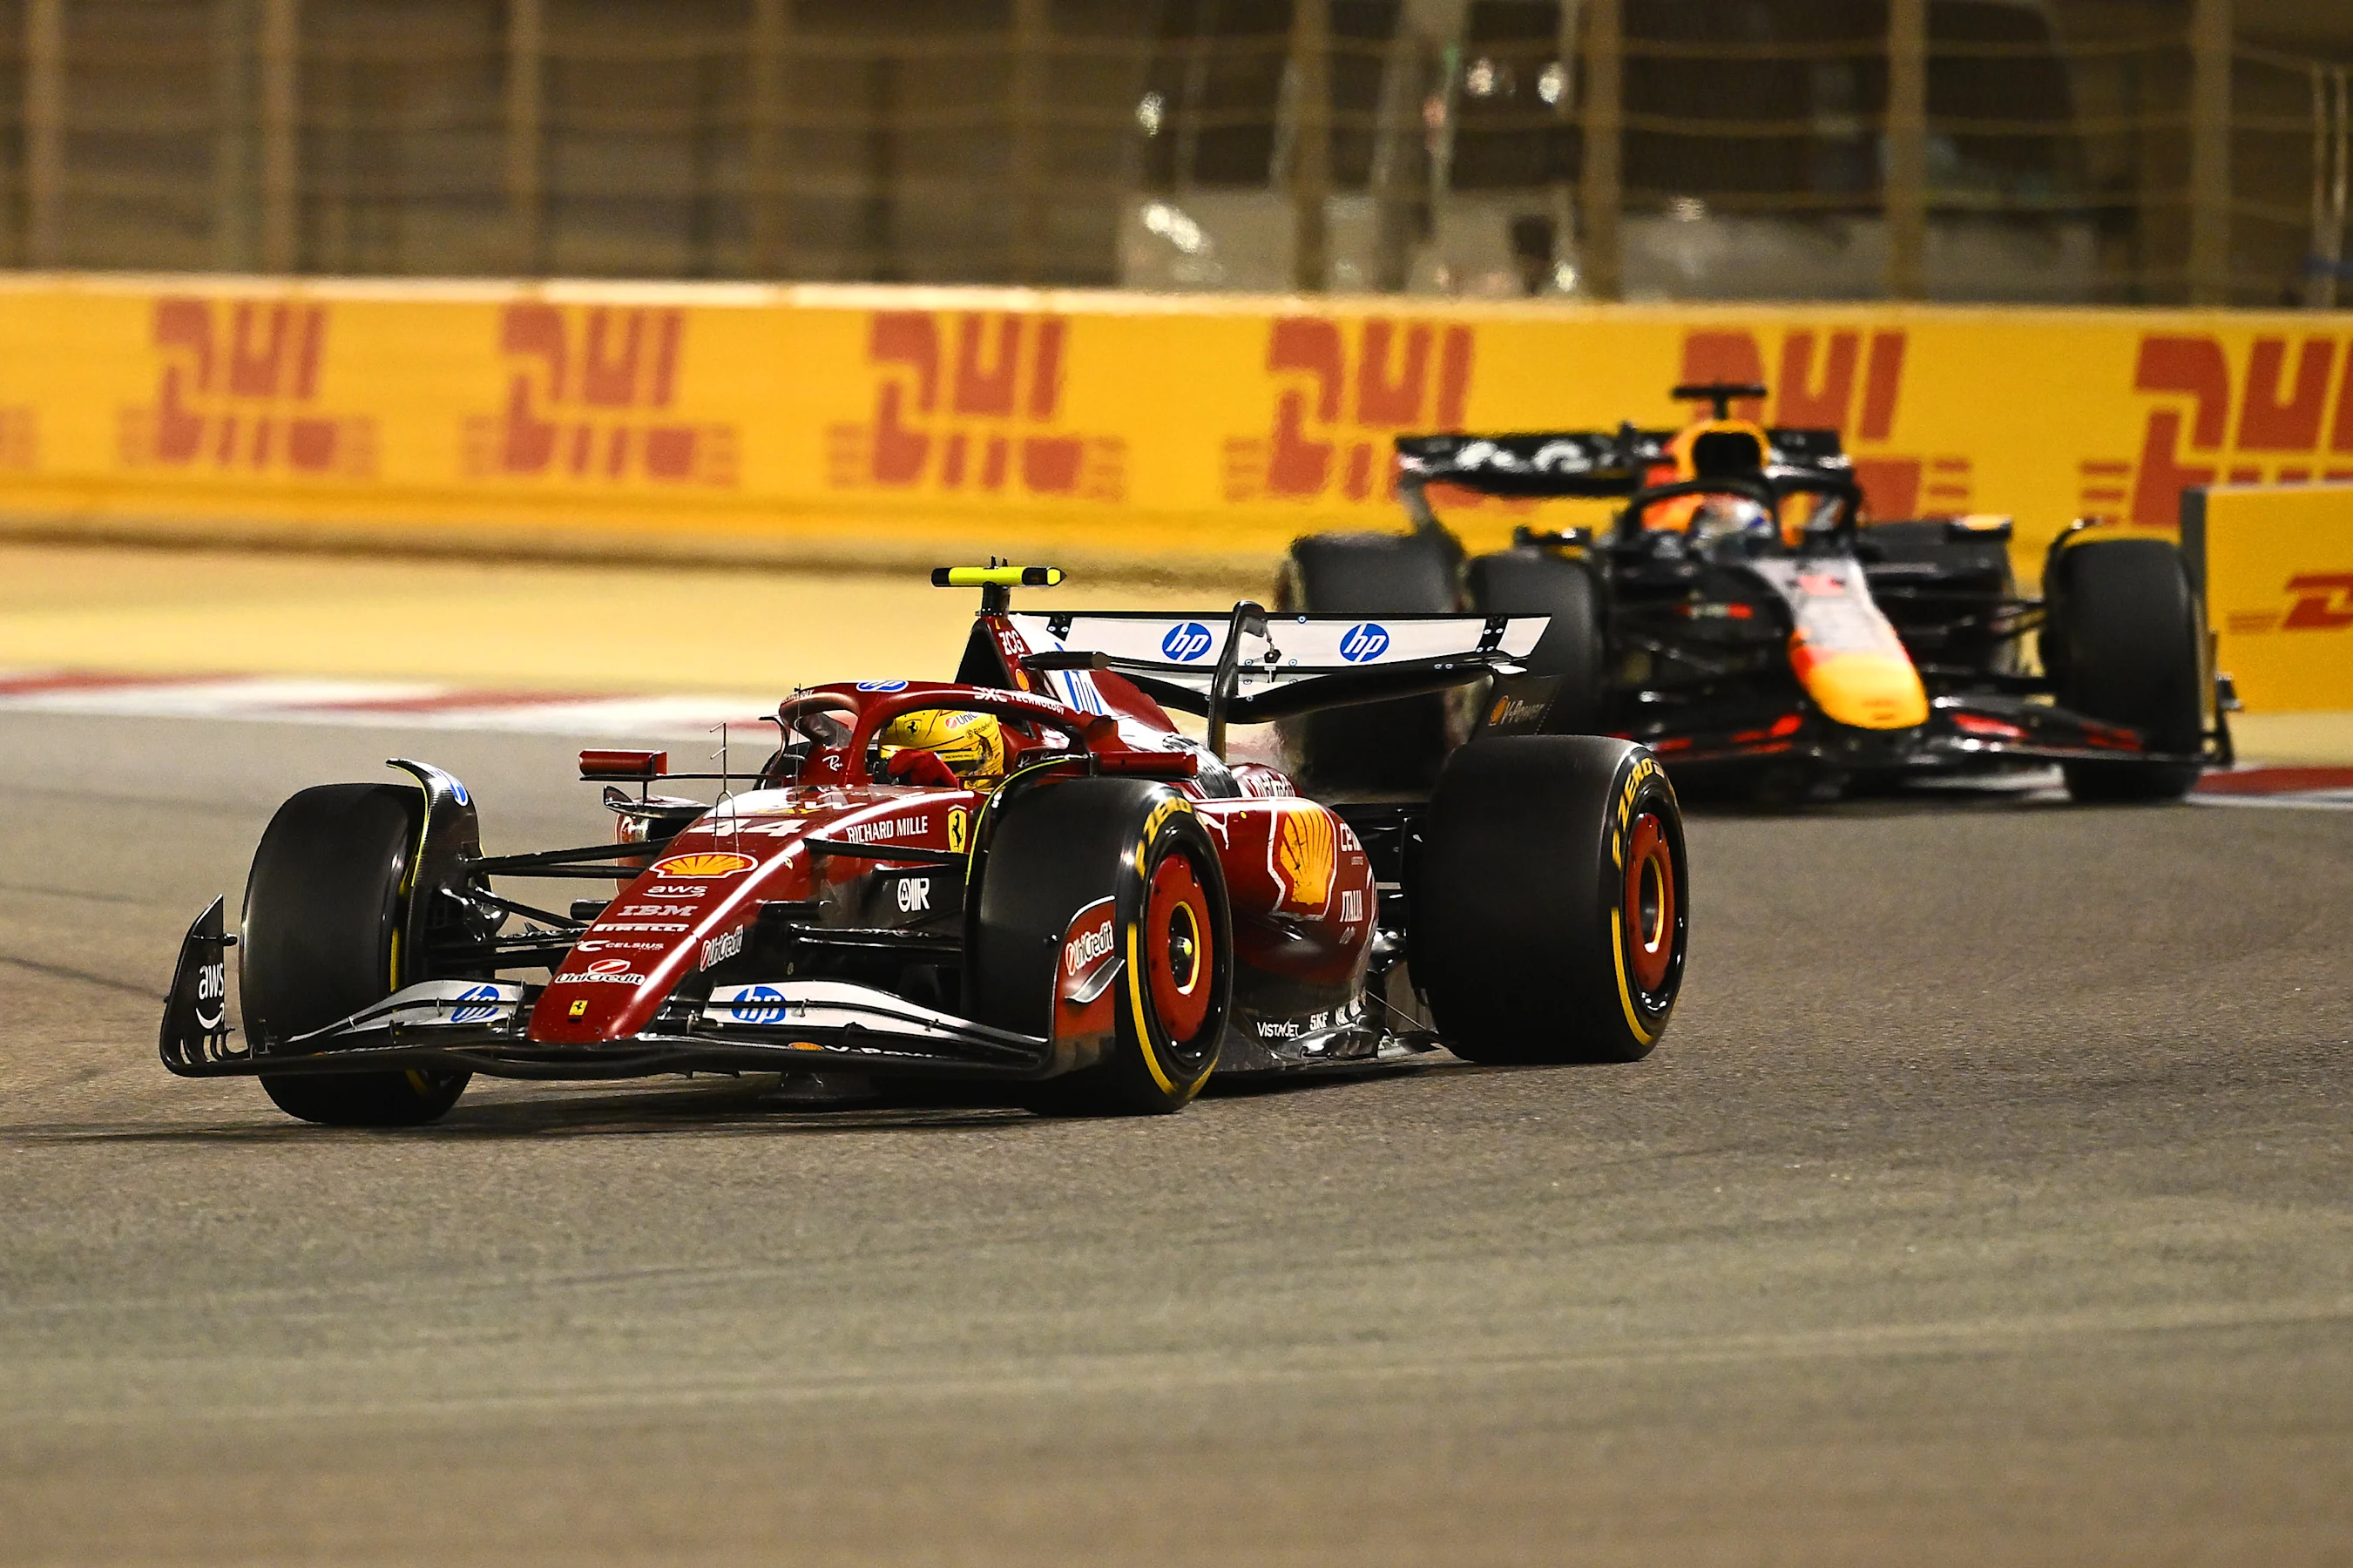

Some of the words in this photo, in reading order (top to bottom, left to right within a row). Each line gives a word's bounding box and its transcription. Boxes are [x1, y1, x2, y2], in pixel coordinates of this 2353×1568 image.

[998, 629, 1024, 655] ZCG
[1163, 622, 1212, 661] hp
[1340, 623, 1389, 662] hp
[846, 820, 894, 843] RICHARD
[896, 815, 928, 837] MILLE
[617, 905, 698, 916] IBM
[199, 962, 224, 1000] aws
[556, 973, 645, 985] UniCredit
[1309, 1011, 1329, 1031] SKF
